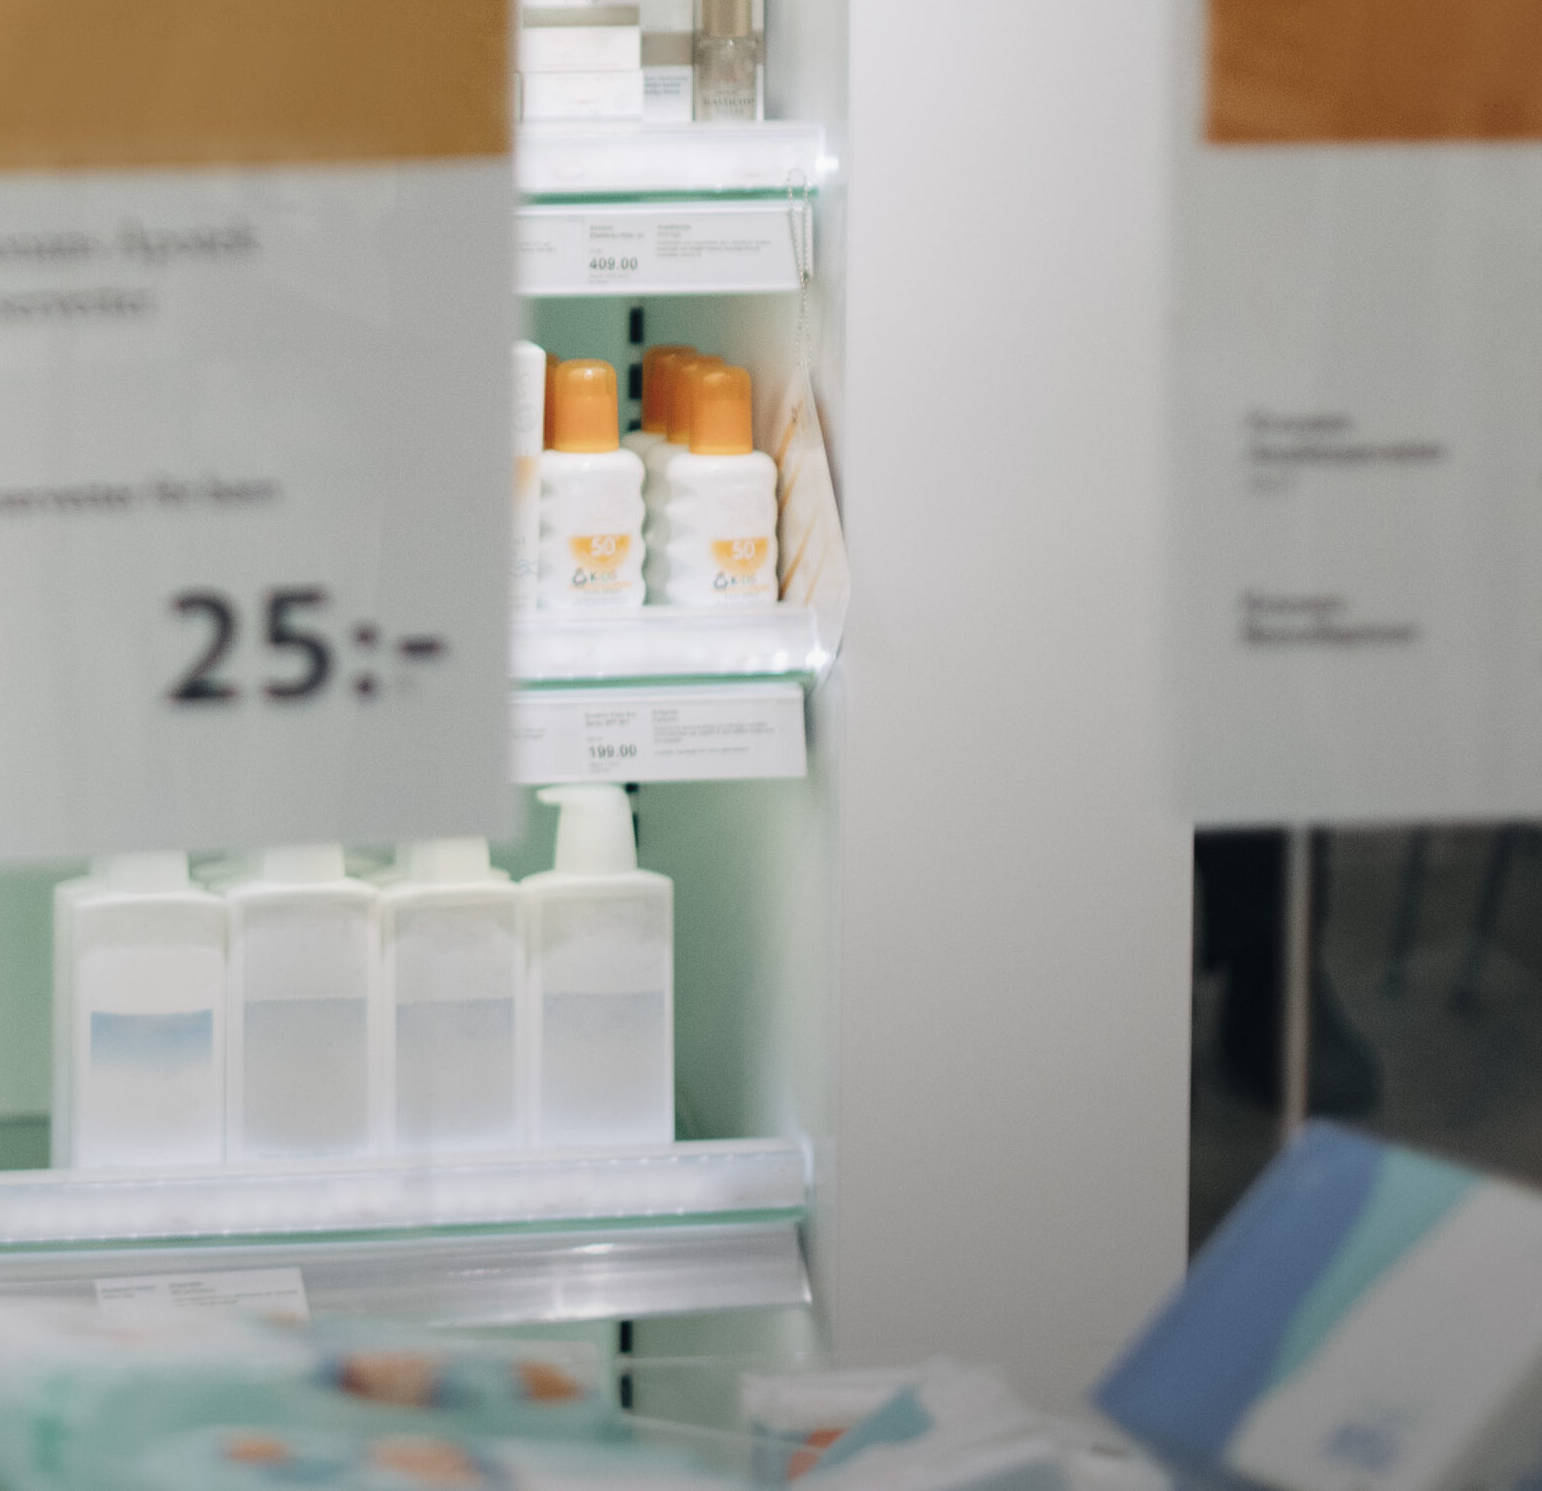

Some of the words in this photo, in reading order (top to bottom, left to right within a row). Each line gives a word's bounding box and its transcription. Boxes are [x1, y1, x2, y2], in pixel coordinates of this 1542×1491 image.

[588, 256, 638, 271] 409.00
[168, 586, 449, 704] 25:-
[589, 744, 637, 759] 199.00
